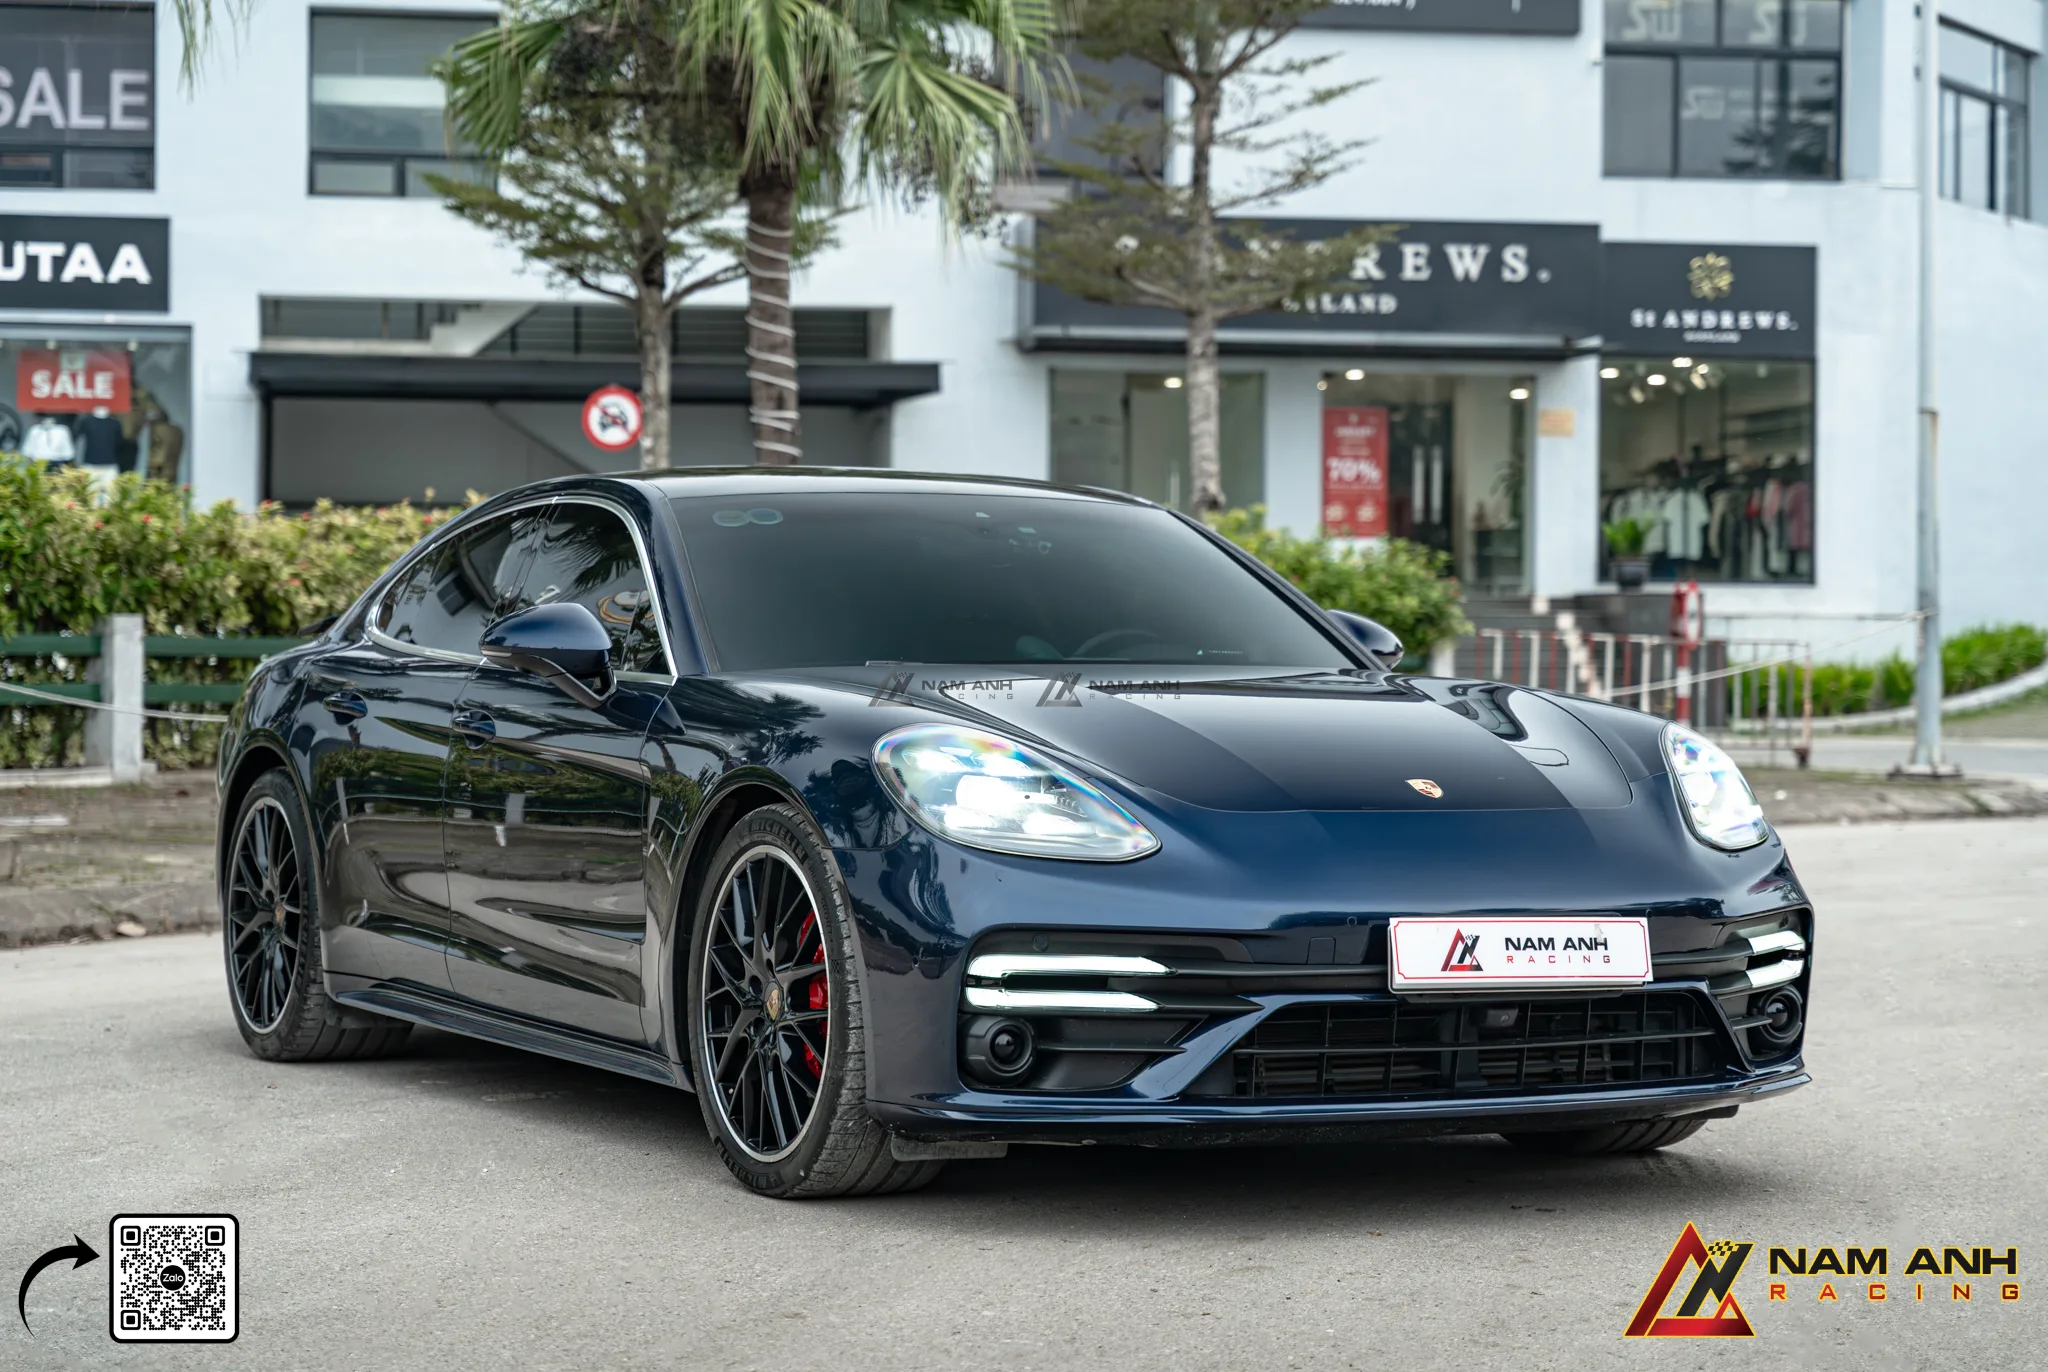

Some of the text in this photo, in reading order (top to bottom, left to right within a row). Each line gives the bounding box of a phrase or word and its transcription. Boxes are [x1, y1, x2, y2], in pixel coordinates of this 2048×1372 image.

[31, 370, 114, 400] SALE
[750, 818, 807, 861] MICHELIN
[1505, 937, 1608, 951] NAM ANH
[1506, 955, 1611, 964] RACING
